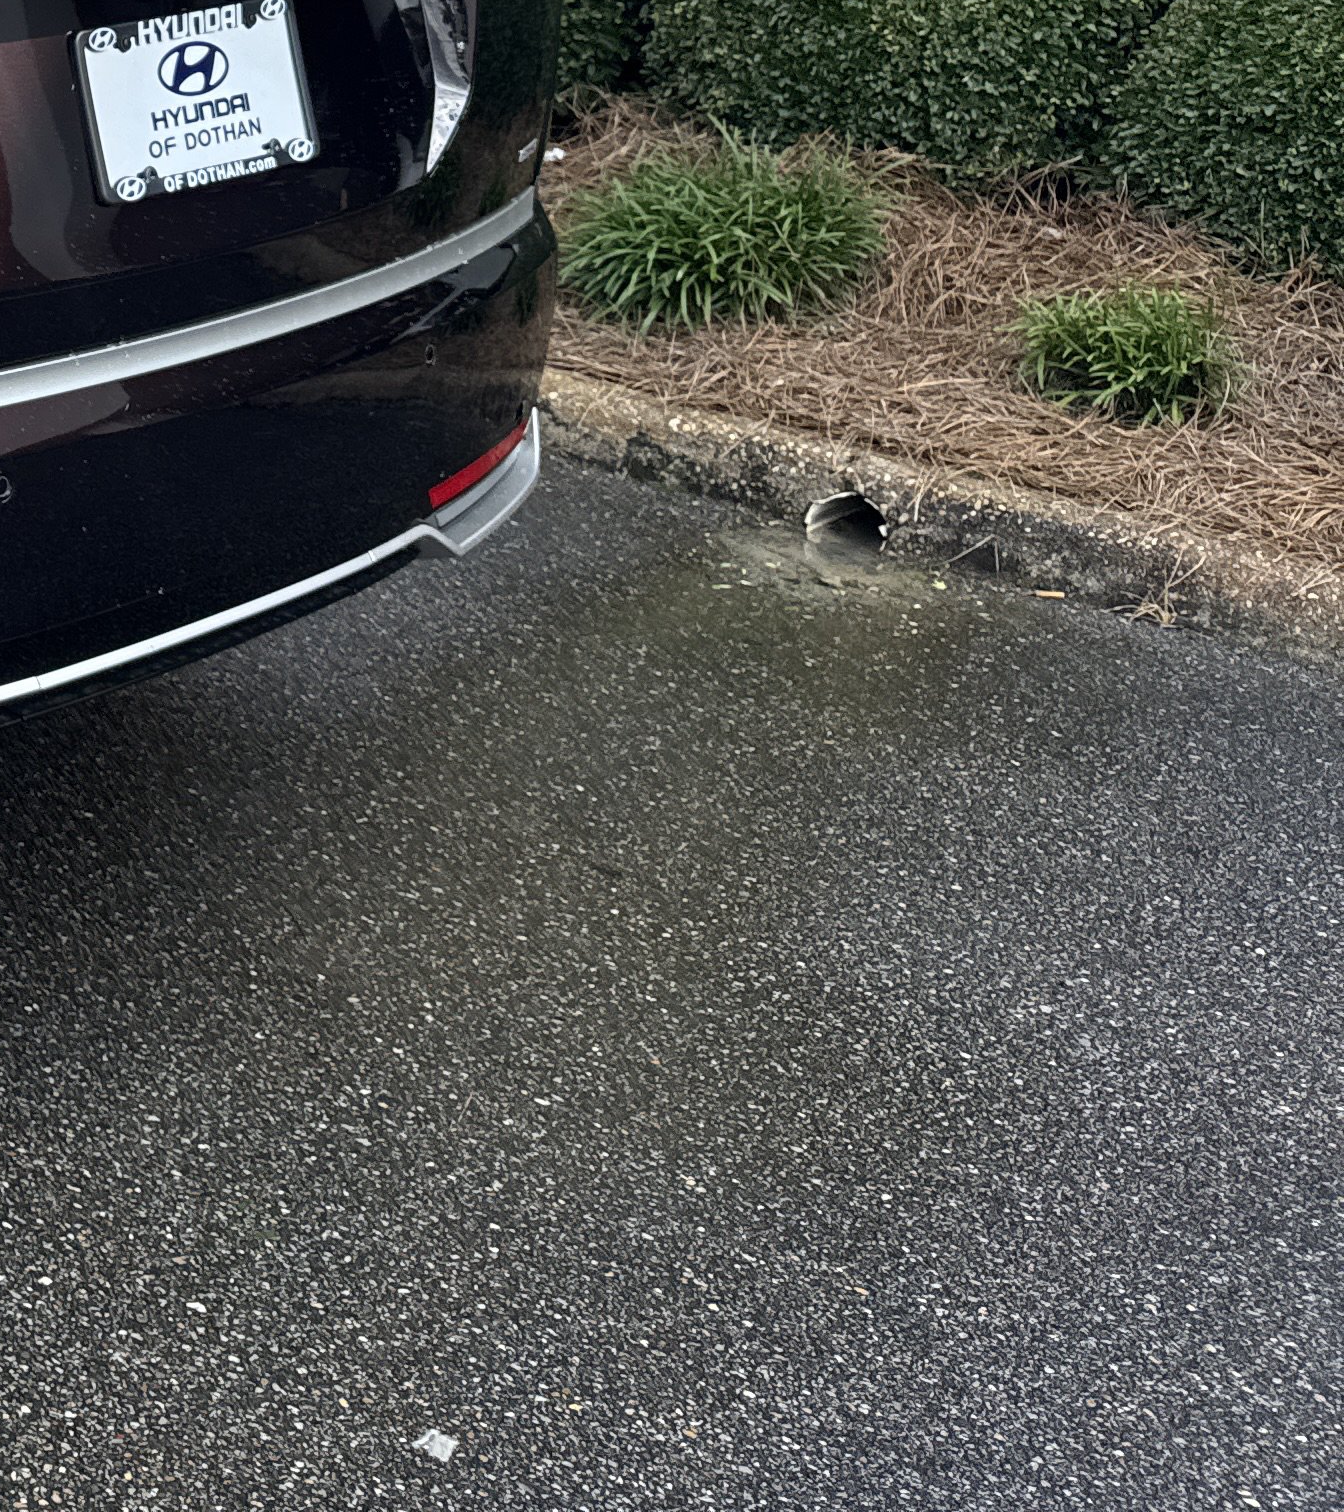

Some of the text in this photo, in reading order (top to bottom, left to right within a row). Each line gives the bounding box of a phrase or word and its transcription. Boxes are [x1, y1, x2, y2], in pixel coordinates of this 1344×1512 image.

[137, 2, 244, 46] HYUNDAI
[151, 92, 251, 131] HYUNDAI
[148, 116, 263, 159] OF DOTHAN
[163, 154, 278, 193] OF DOTHAN.com
